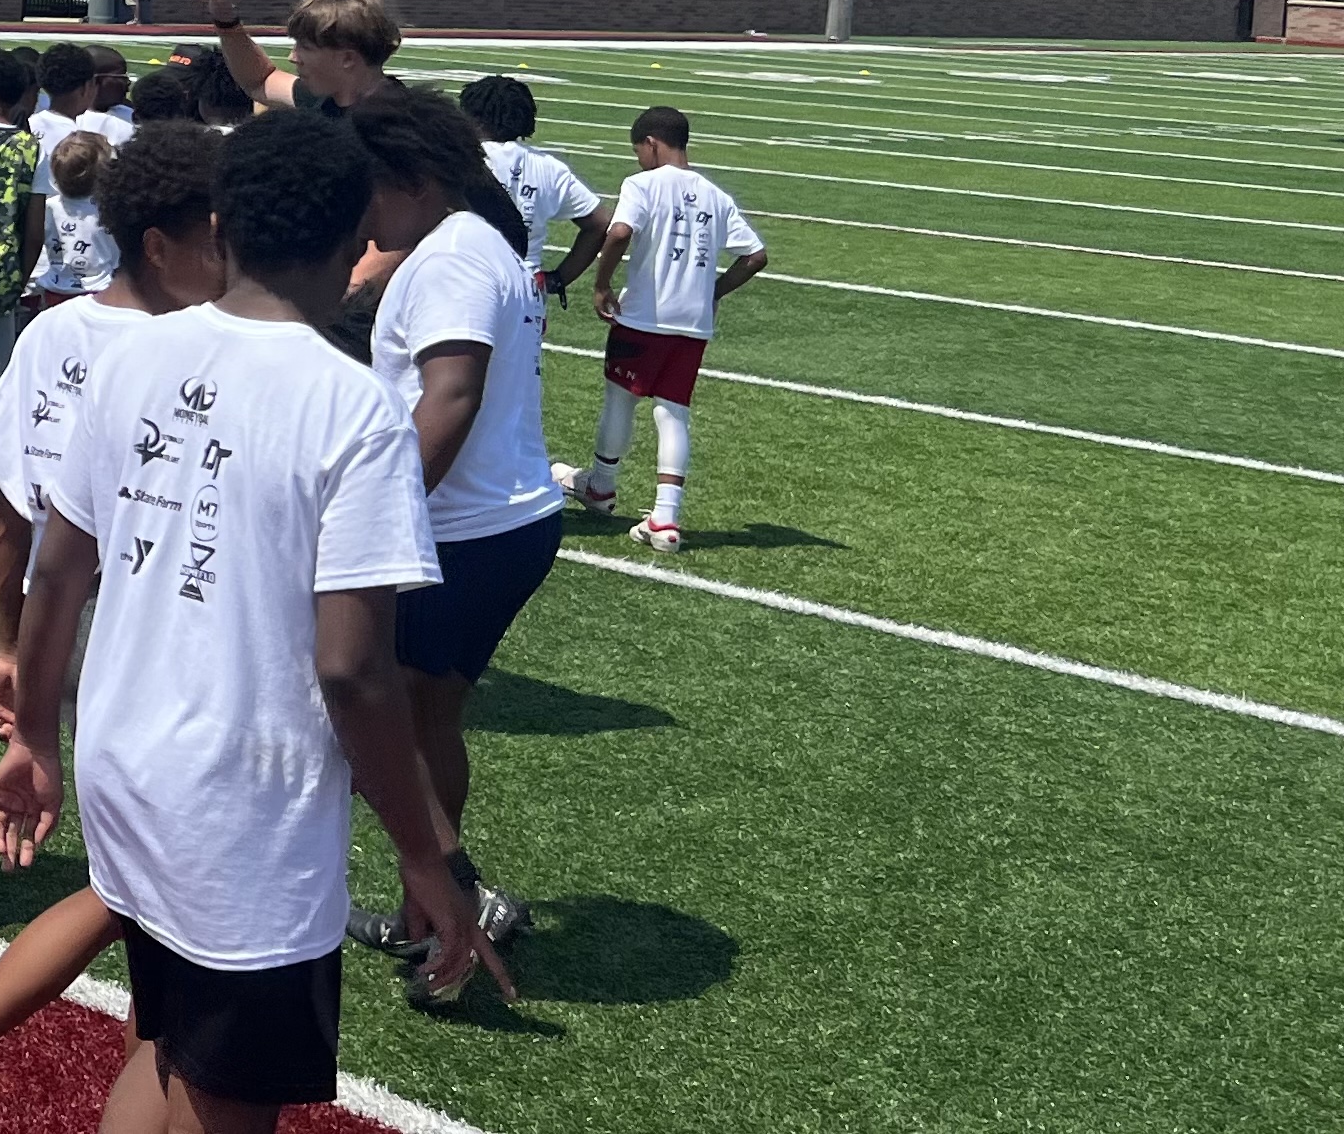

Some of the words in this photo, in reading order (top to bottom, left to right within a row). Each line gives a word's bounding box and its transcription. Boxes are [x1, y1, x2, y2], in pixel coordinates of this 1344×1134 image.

[201, 438, 232, 480] DT
[133, 489, 156, 506] State
[156, 495, 182, 512] Farm
[197, 499, 218, 518] M7
